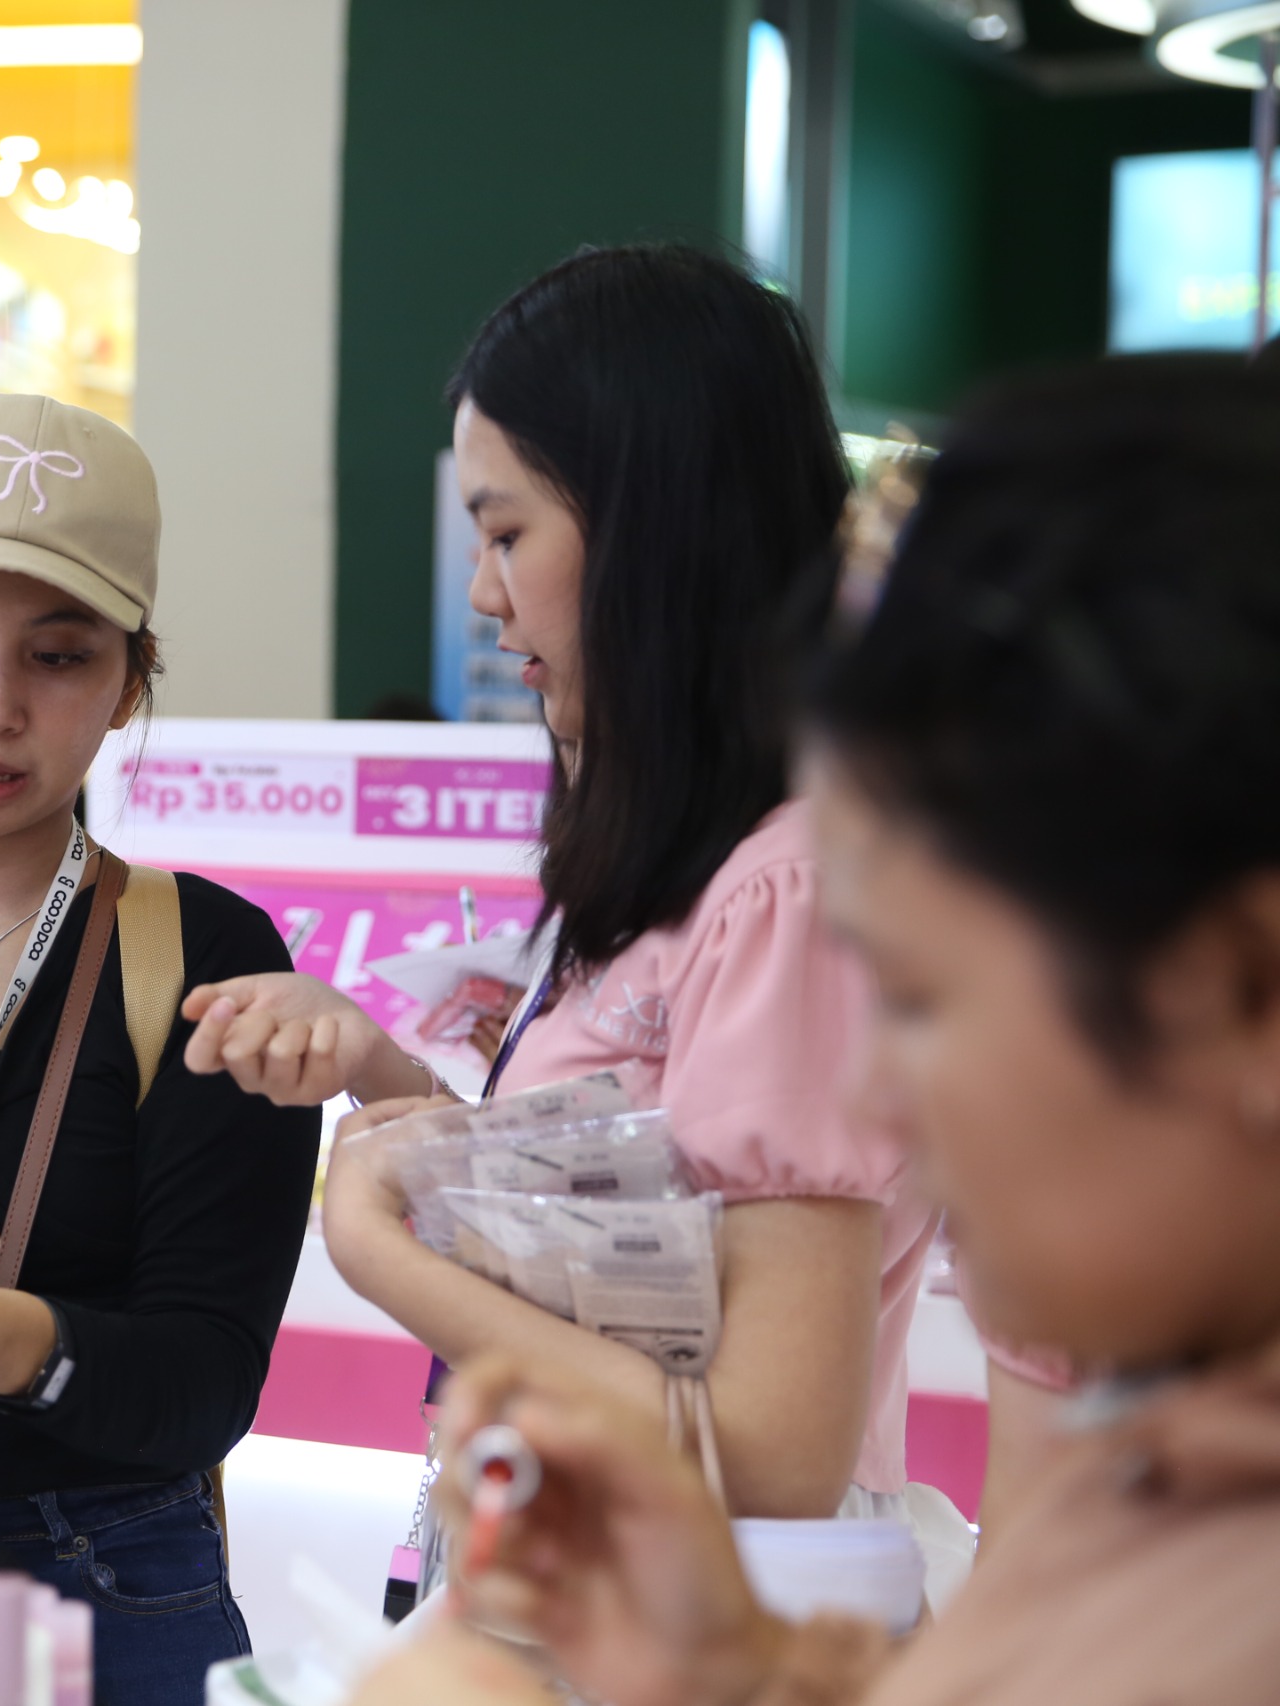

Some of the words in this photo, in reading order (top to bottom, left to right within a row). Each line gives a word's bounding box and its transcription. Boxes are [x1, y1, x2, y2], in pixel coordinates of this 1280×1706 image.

[131, 781, 185, 820] Rp
[195, 781, 345, 816] 35.000
[392, 785, 431, 830] 3
[435, 786, 547, 832] ITE
